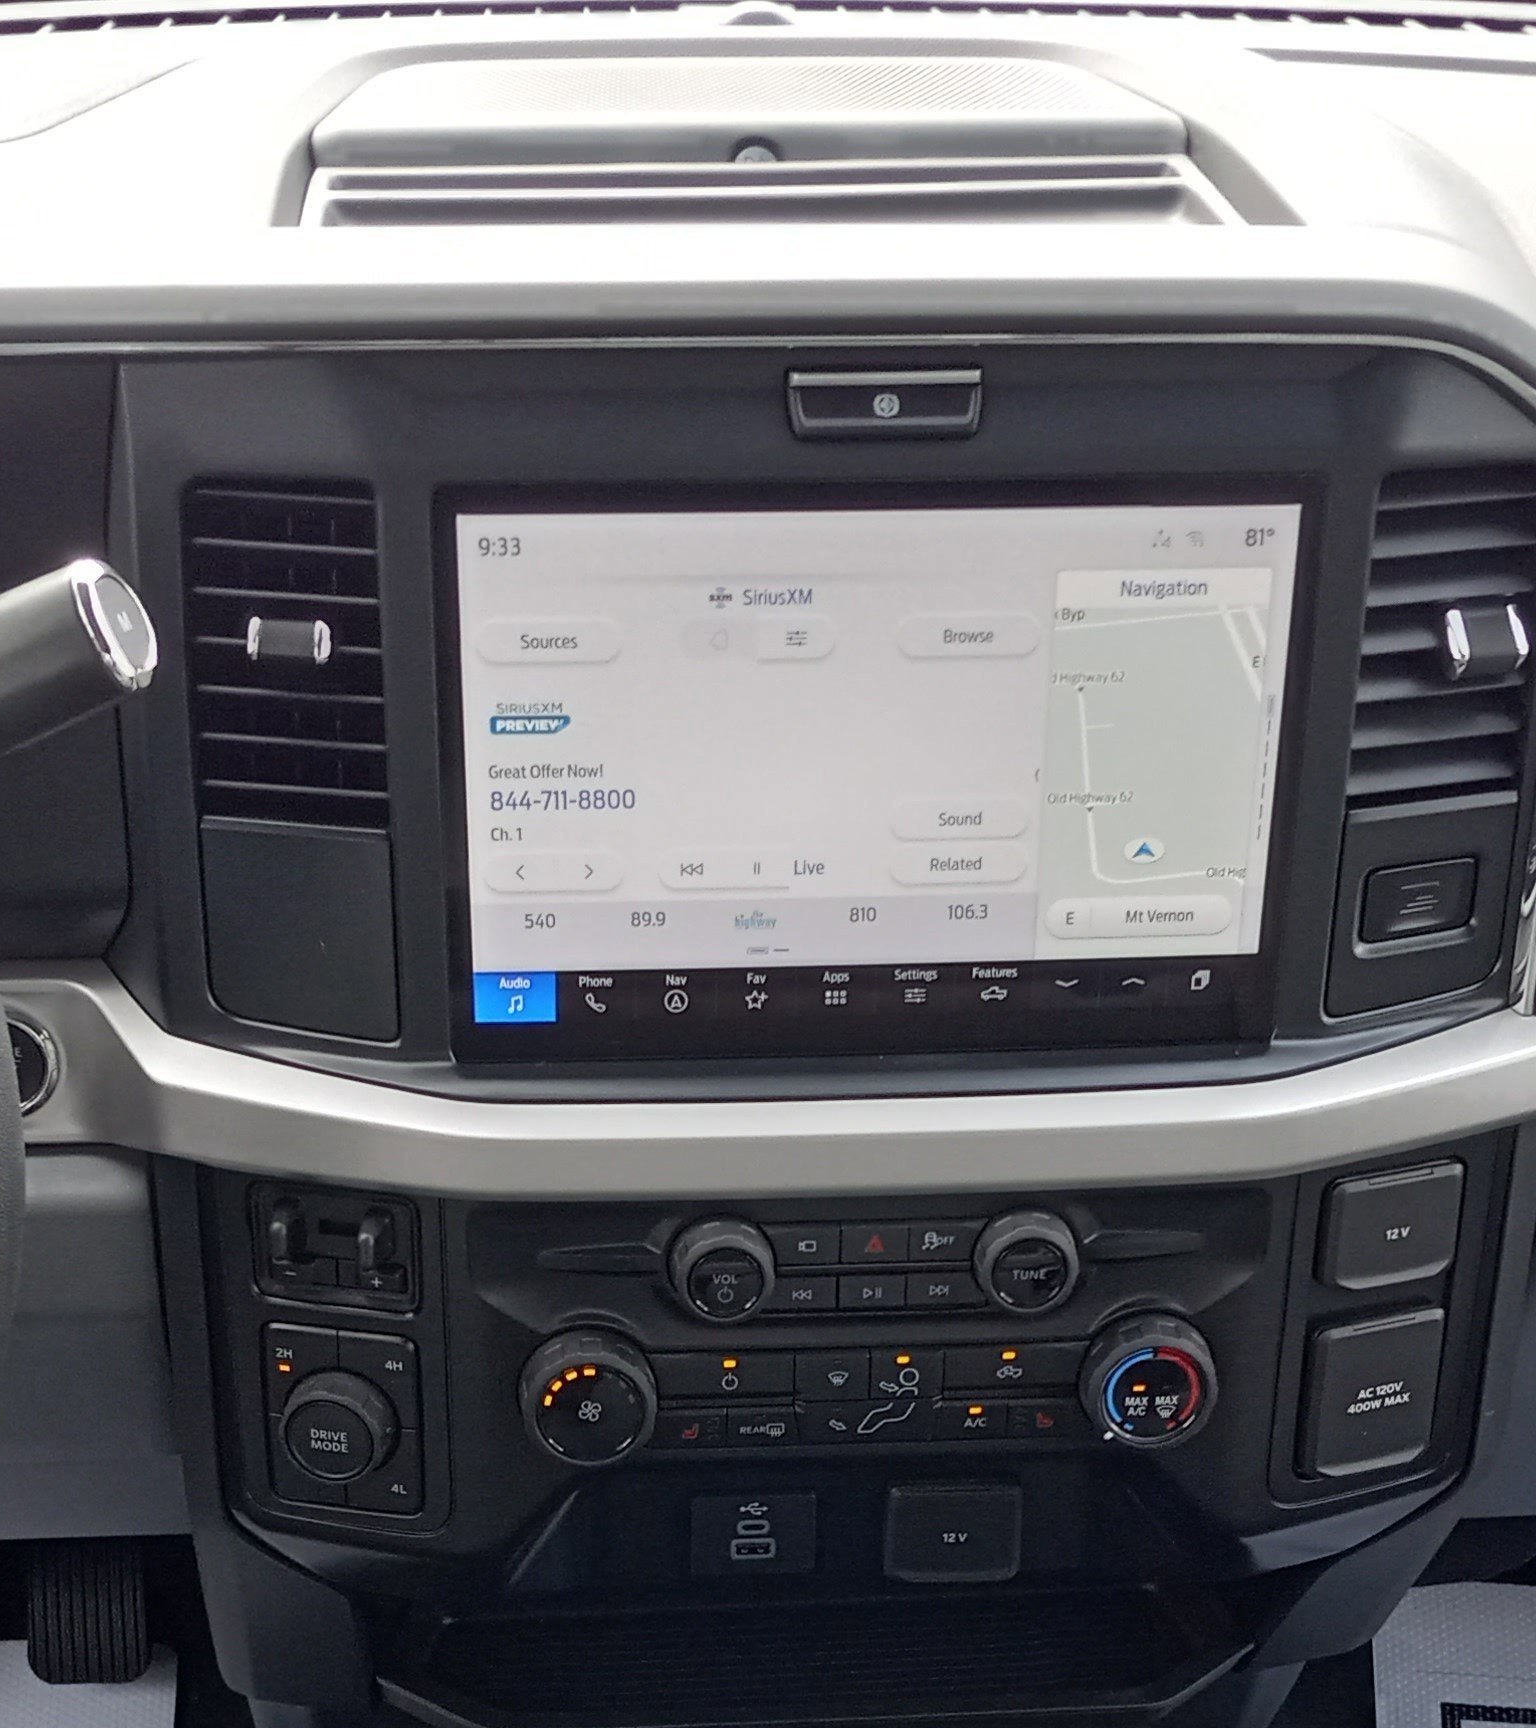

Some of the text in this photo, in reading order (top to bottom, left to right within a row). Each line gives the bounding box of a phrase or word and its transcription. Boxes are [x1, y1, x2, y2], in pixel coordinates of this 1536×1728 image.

[1245, 527, 1275, 547] 81°
[478, 537, 522, 557] 9:33
[742, 588, 814, 606] SiriusXM
[1120, 580, 1208, 600] Navigation
[520, 634, 578, 650] Sources
[943, 629, 994, 645] Browse
[495, 719, 565, 733] PREVIEW
[488, 763, 604, 779] Great Offer Now!
[490, 789, 636, 811] 844-711-8800
[1069, 792, 1116, 805] Highway
[1119, 790, 1134, 803] 62
[938, 811, 983, 827] Sound
[490, 827, 523, 842] Ch. 1
[793, 858, 825, 878] Live
[929, 857, 983, 872] Related
[630, 911, 666, 928] 89.9
[849, 907, 877, 923] 810
[947, 904, 988, 920] 106.3
[1065, 912, 1075, 925] E
[1125, 909, 1194, 924] Mt Vernon
[524, 913, 556, 929] 540
[665, 974, 687, 987] Nav
[746, 972, 767, 985] Fav
[822, 970, 850, 984] Apps
[894, 968, 938, 982] Settings
[971, 967, 1018, 980] Features
[499, 976, 531, 990] Audio
[578, 975, 613, 988] Phone
[936, 1235, 955, 1247] OFF
[1385, 1226, 1411, 1241] 12 V
[713, 1273, 738, 1285] VOL
[1013, 1268, 1047, 1281] TUNE
[275, 1348, 293, 1360] 2H
[384, 1360, 403, 1372] 4H
[1357, 1381, 1404, 1400] AC 120V
[1124, 1396, 1149, 1407] MAX
[1154, 1395, 1179, 1406] MAX
[1347, 1391, 1411, 1416] 400W MAX
[1127, 1406, 1147, 1417] A/C
[964, 1416, 987, 1428] A/C
[310, 1428, 348, 1443] DRIVE
[739, 1425, 766, 1436] REAR
[310, 1439, 349, 1454] MODE
[390, 1483, 408, 1495] 4L
[941, 1531, 969, 1544] 12 V
